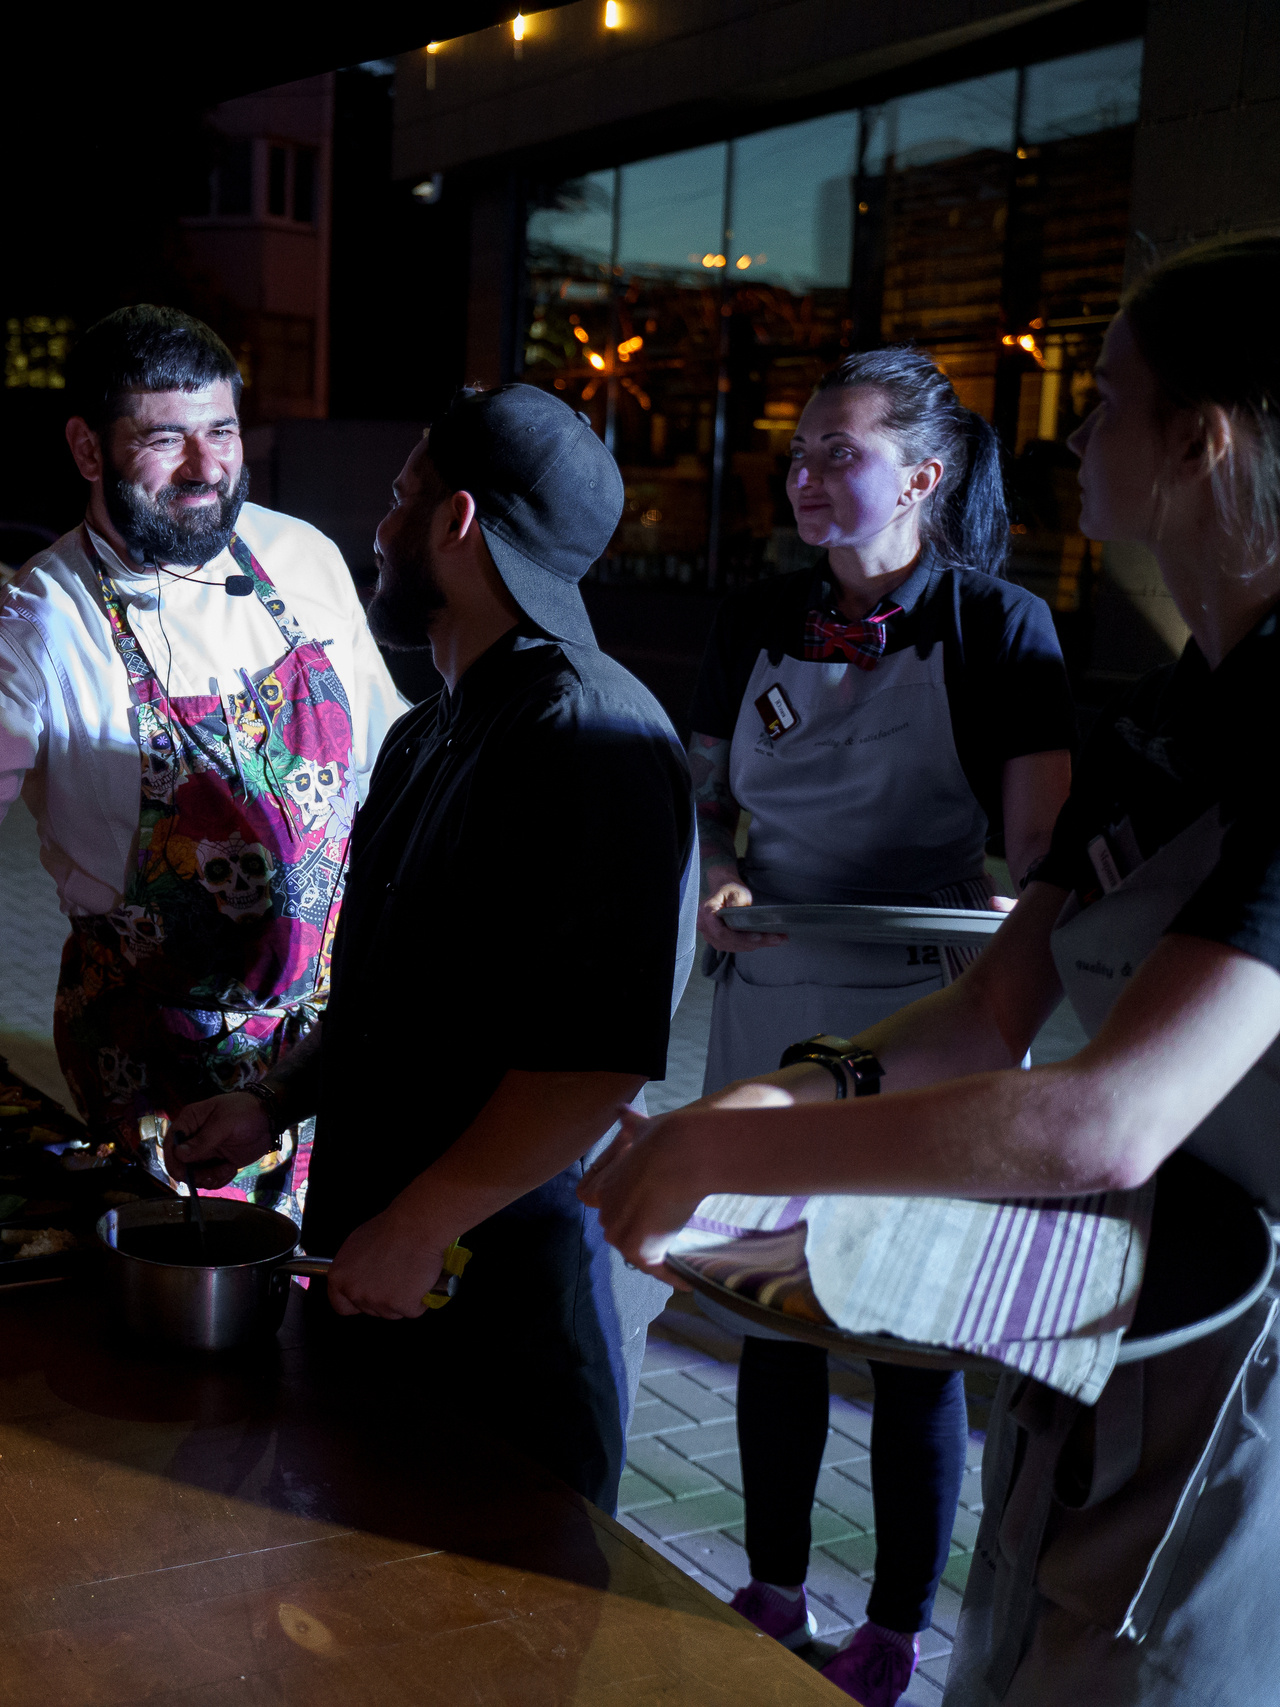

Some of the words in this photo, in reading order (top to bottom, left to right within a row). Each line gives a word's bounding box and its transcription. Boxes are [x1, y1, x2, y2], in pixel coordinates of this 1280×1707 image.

[844, 735, 854, 746] &
[859, 721, 910, 744] satisfaction
[906, 945, 940, 966] 12
